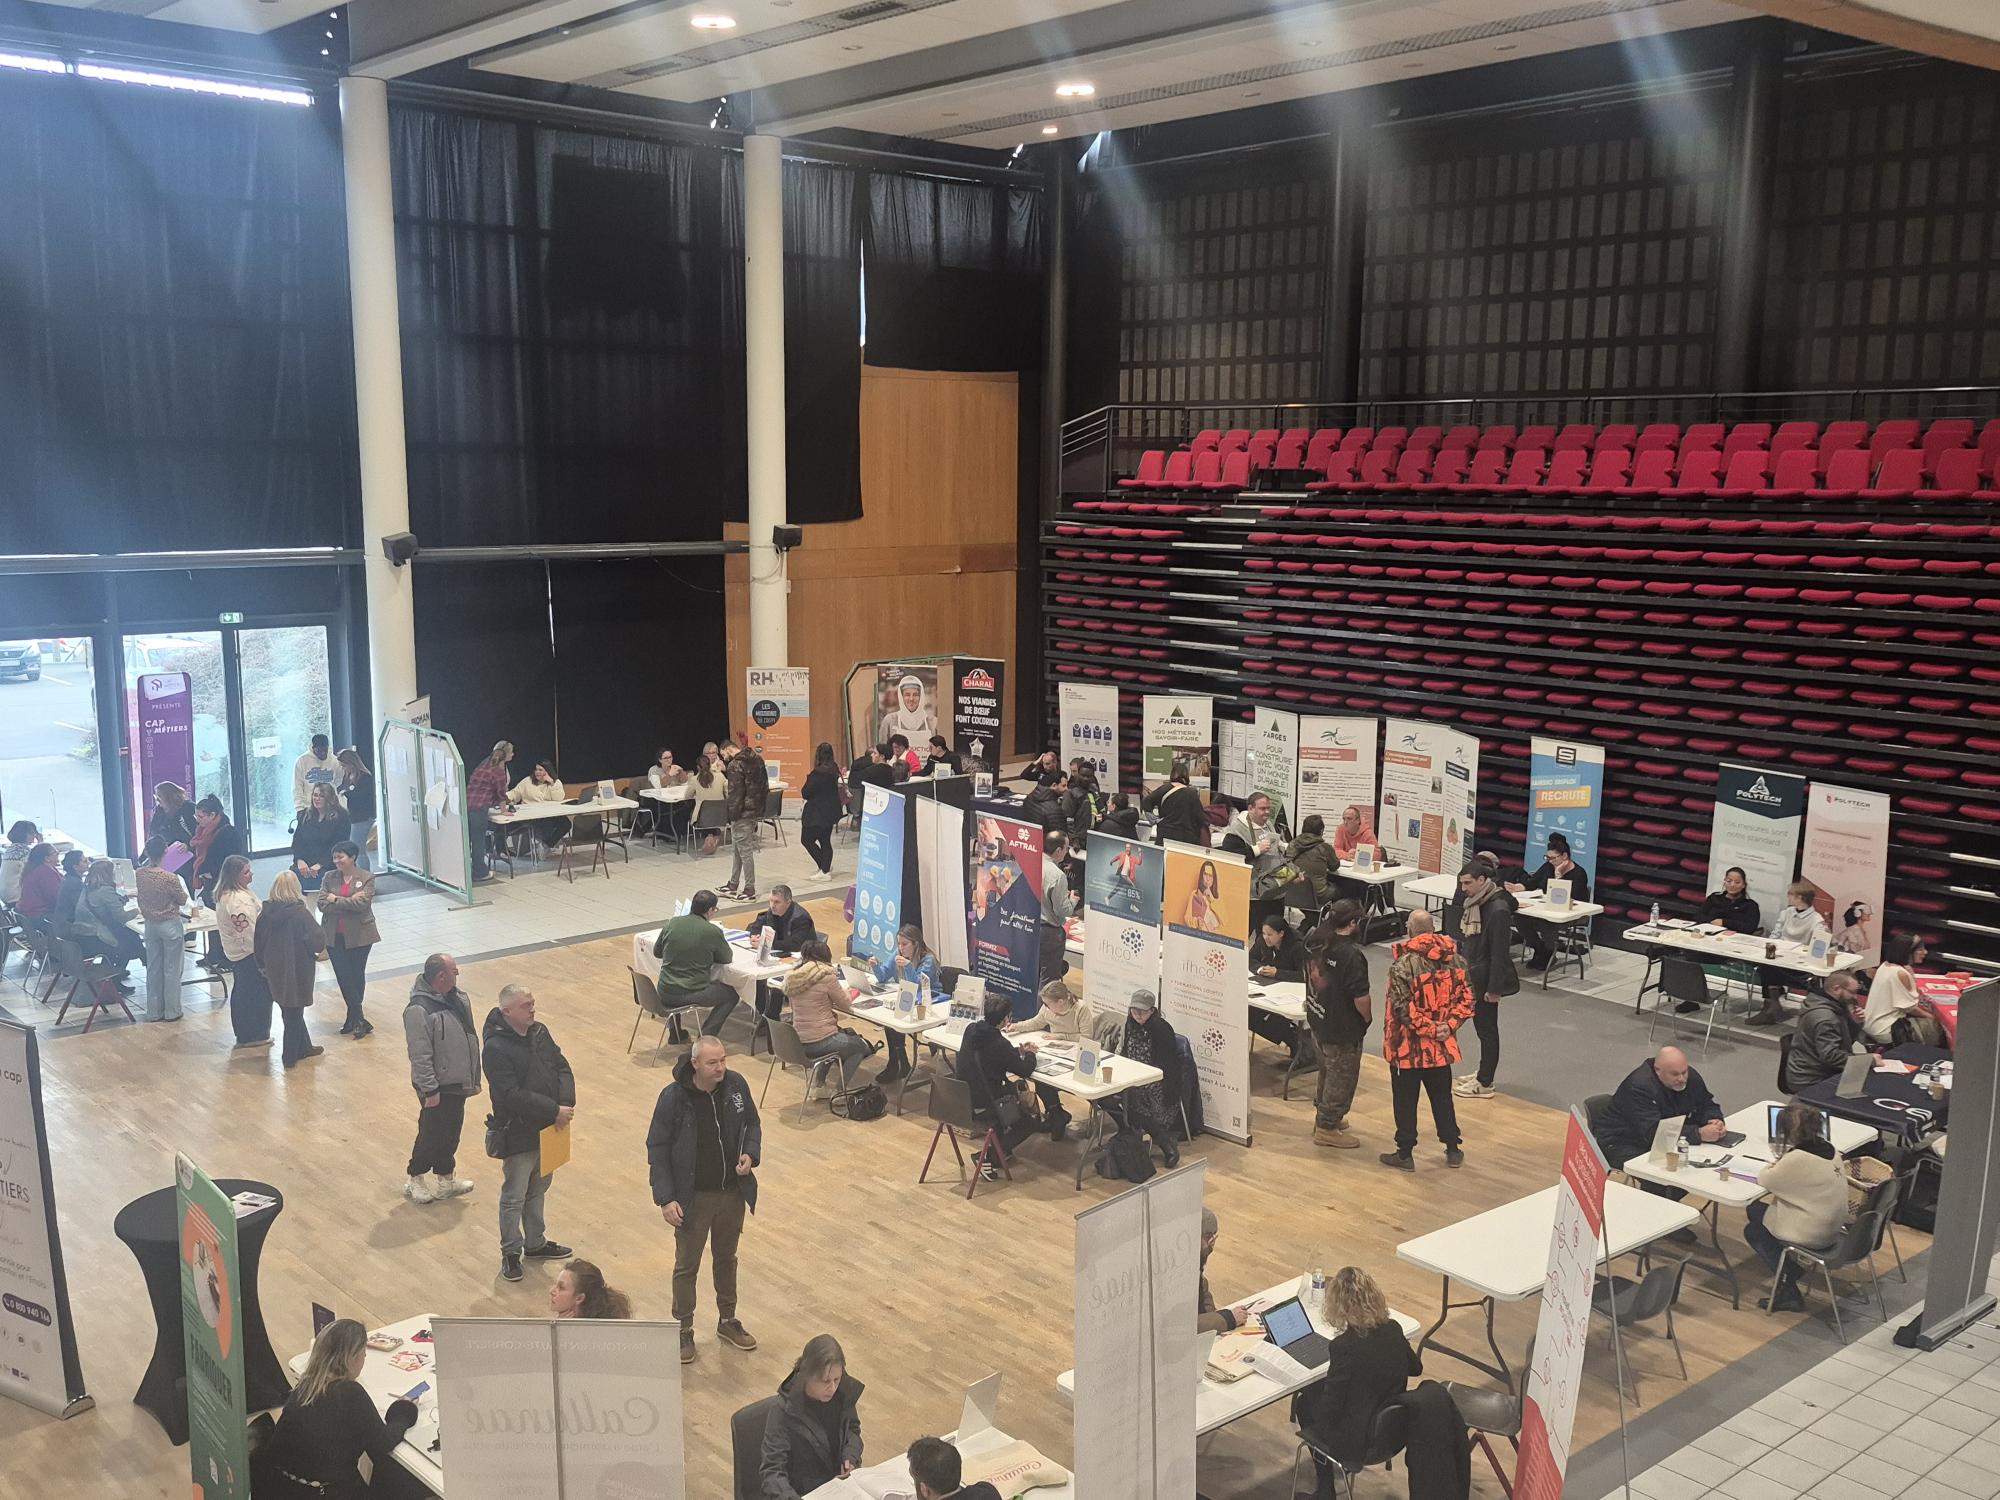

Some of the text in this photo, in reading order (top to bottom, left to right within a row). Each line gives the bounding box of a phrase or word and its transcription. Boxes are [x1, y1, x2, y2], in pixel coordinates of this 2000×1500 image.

[964, 679, 992, 688] CHARAL
[958, 696, 997, 707] NOS VIANDES
[964, 706, 972, 714] DE
[145, 720, 165, 728] CAP
[955, 714, 999, 726] FONT COCORICO
[1158, 718, 1196, 726] FARGES
[154, 725, 188, 734] MÉTIERS
[1264, 730, 1287, 742] FARGES
[1266, 744, 1283, 754] POUR
[1256, 750, 1294, 766] CONSTRUIRE
[1258, 760, 1290, 773] AVEC VOUS
[1268, 769, 1289, 782] MONDE
[1541, 790, 1586, 801] RECRUTE
[1736, 789, 1782, 802] POLYTECH
[1834, 797, 1870, 808] POLYTECH
[1008, 840, 1038, 852] AFTRAL
[1127, 888, 1140, 900] 85%
[1182, 960, 1215, 978] ifhco
[4, 1069, 22, 1085] cap
